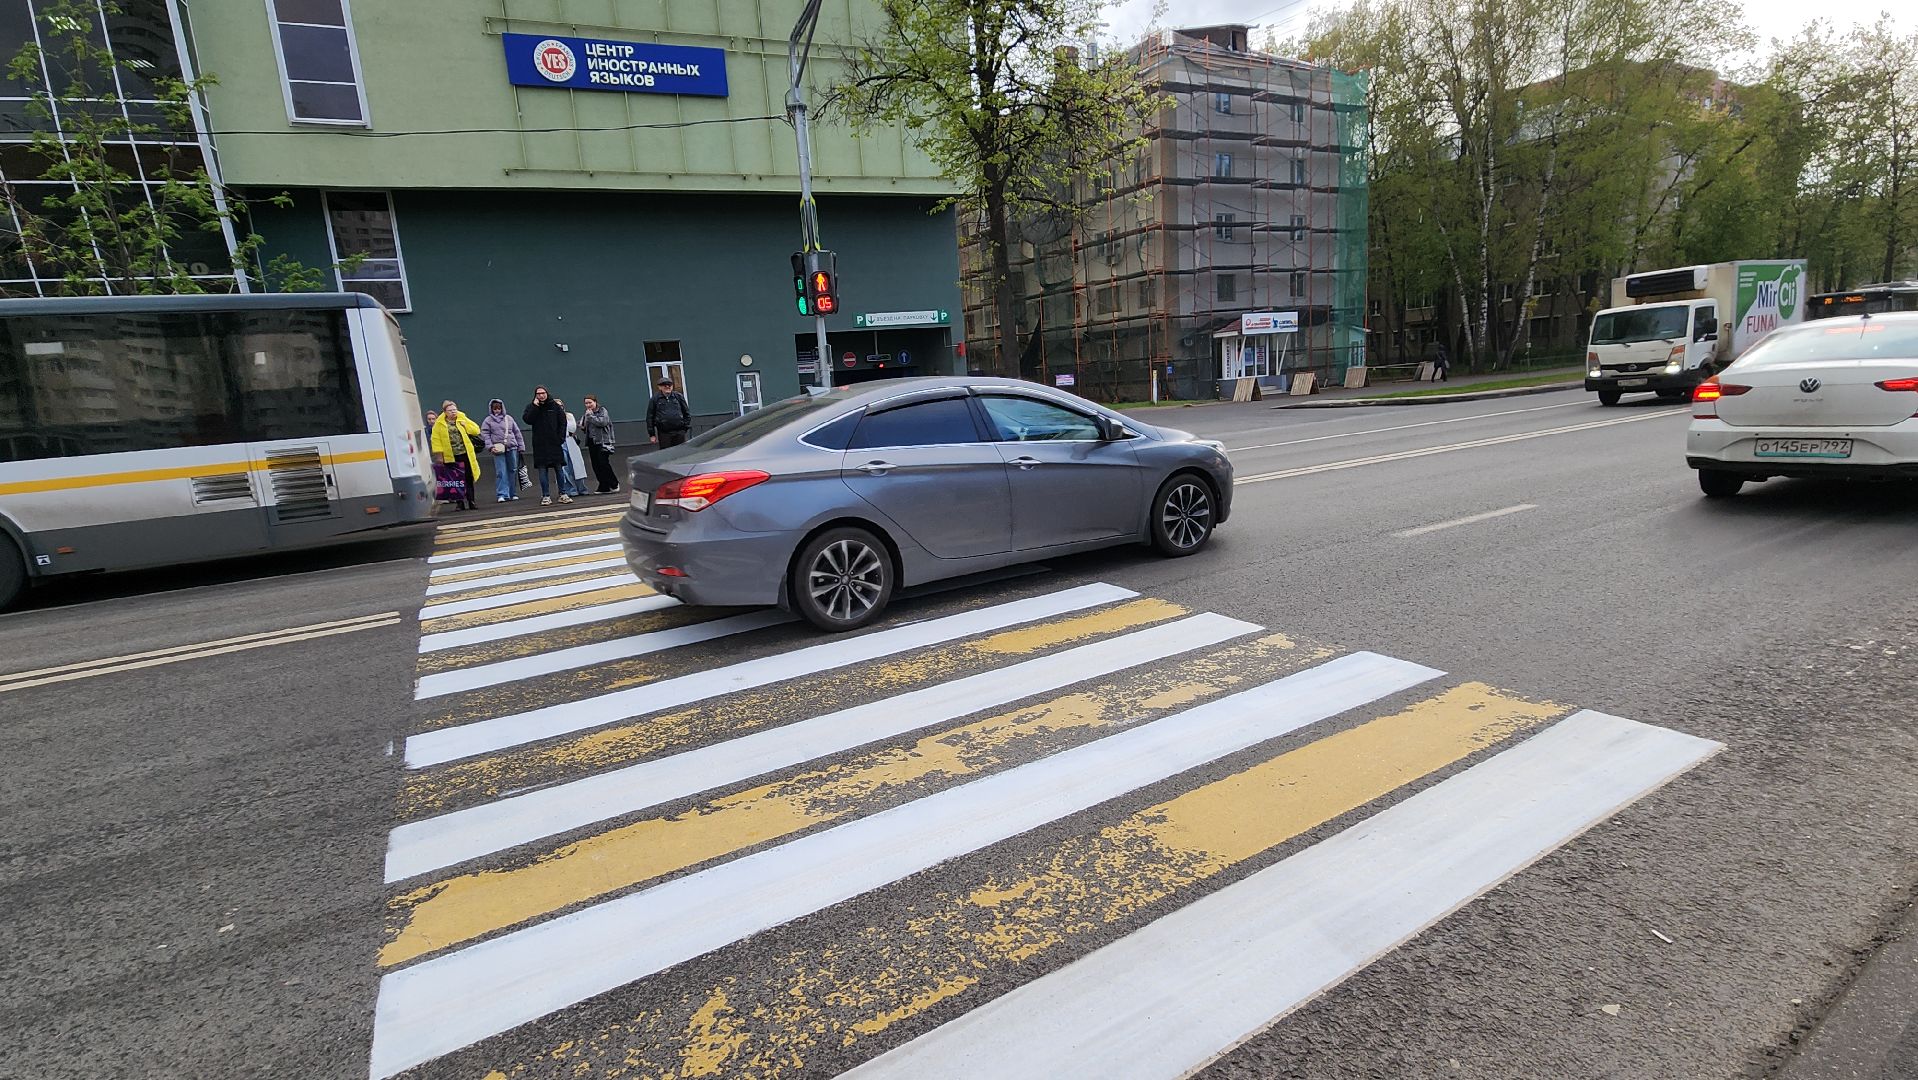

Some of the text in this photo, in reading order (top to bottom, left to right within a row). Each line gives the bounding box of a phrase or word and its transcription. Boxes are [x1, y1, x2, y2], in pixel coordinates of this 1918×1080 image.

[584, 42, 634, 59] ЦЕНТР
[543, 52, 567, 70] YES
[587, 57, 700, 77] ИНОСТРАННЫХ
[590, 71, 655, 87] ЯЗЫКОВ
[817, 297, 832, 309] 05
